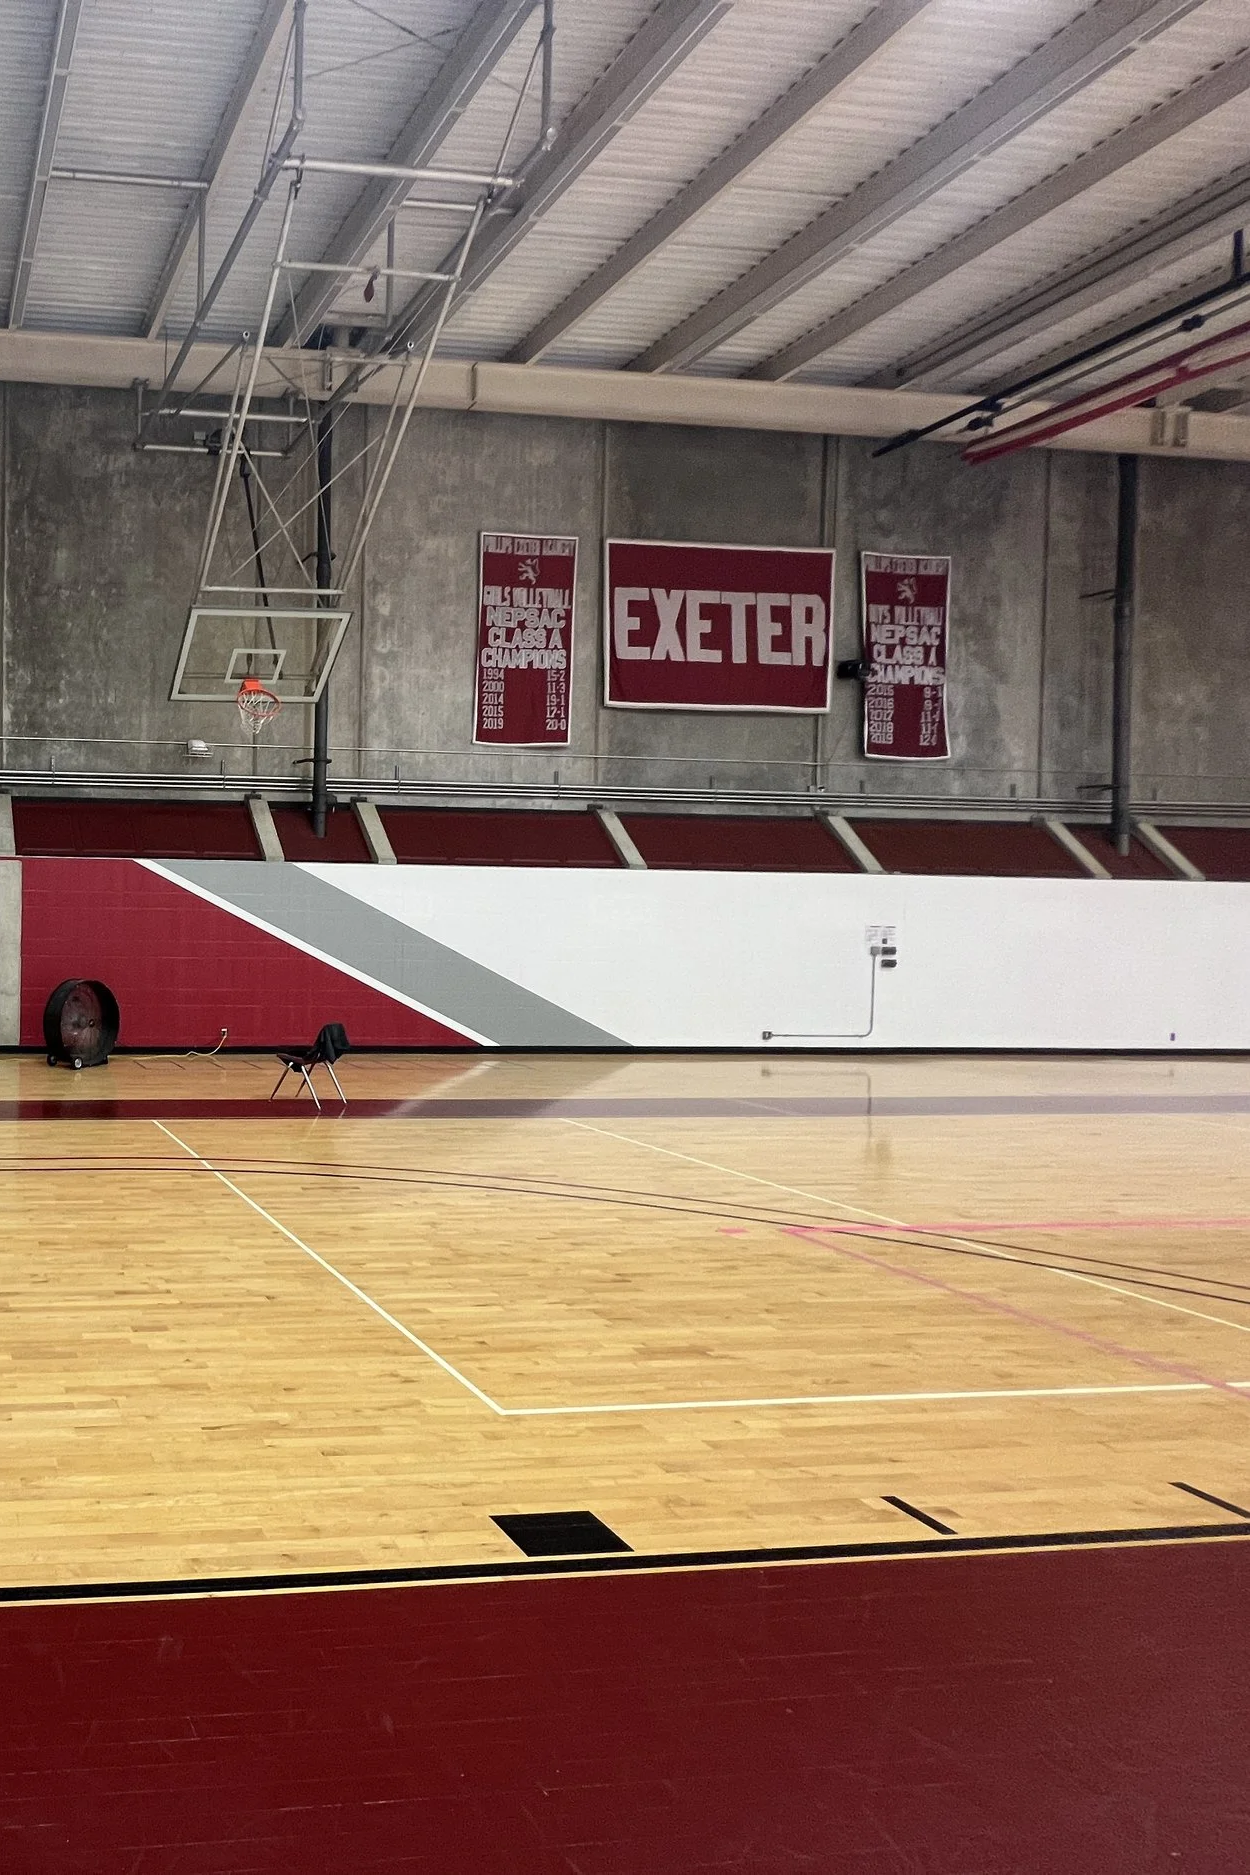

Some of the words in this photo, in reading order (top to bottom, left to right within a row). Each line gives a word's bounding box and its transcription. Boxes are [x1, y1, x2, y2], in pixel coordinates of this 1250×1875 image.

[486, 606, 566, 628] NEPSAC
[614, 587, 827, 667] EXETER
[488, 627, 547, 648] CLASS
[548, 628, 563, 649] A
[871, 623, 941, 646] NEPSAC
[481, 648, 567, 670] CHAMPIONS
[873, 643, 924, 665] CLASS
[928, 646, 937, 666] A
[867, 663, 946, 685] CHAMPIONS
[482, 693, 504, 705] 2014
[482, 705, 504, 717] 2015
[482, 717, 504, 730] 2019
